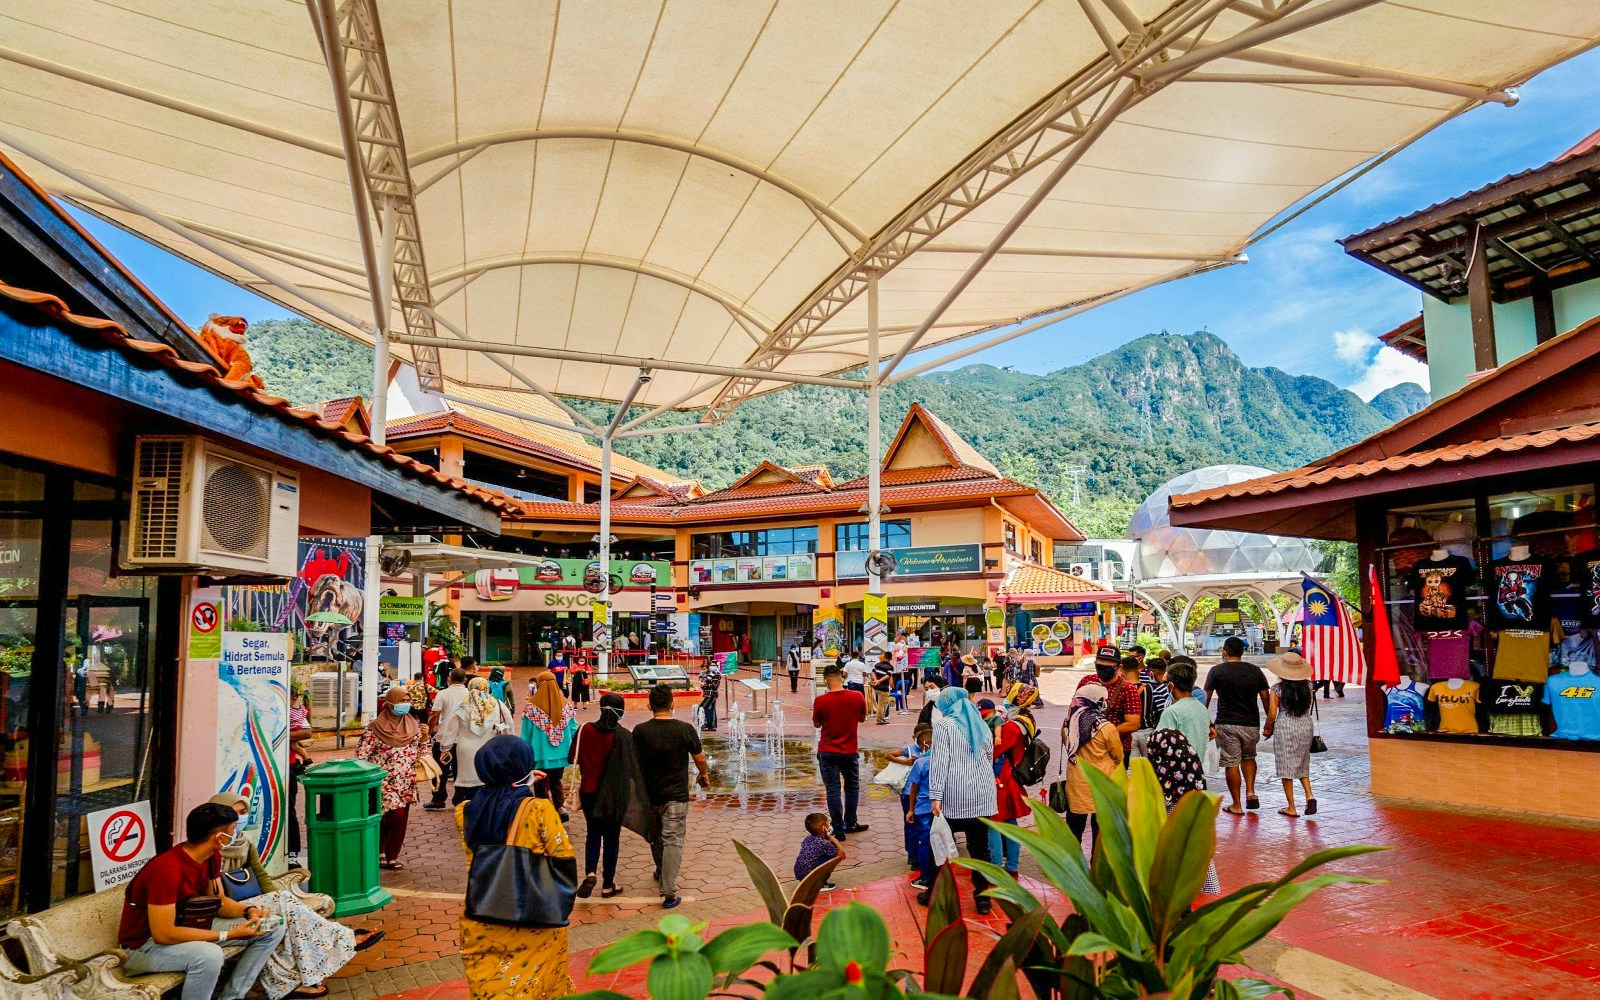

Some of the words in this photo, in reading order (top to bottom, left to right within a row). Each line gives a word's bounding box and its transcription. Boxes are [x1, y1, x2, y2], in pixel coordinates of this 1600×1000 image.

[321, 537, 364, 548] DIMENSIO
[387, 602, 424, 610] CINEMOTION
[544, 593, 598, 609] SkyCa
[242, 637, 270, 651] Segar,
[224, 651, 252, 662] Hidrat
[254, 651, 285, 661] Semula
[226, 665, 236, 675] &
[237, 665, 282, 676] Bertenaga
[1559, 686, 1597, 699] 46
[248, 785, 262, 825] PLUS
[100, 863, 127, 878] DILARANG
[104, 876, 116, 886] NO
[117, 867, 141, 882] SMOK
